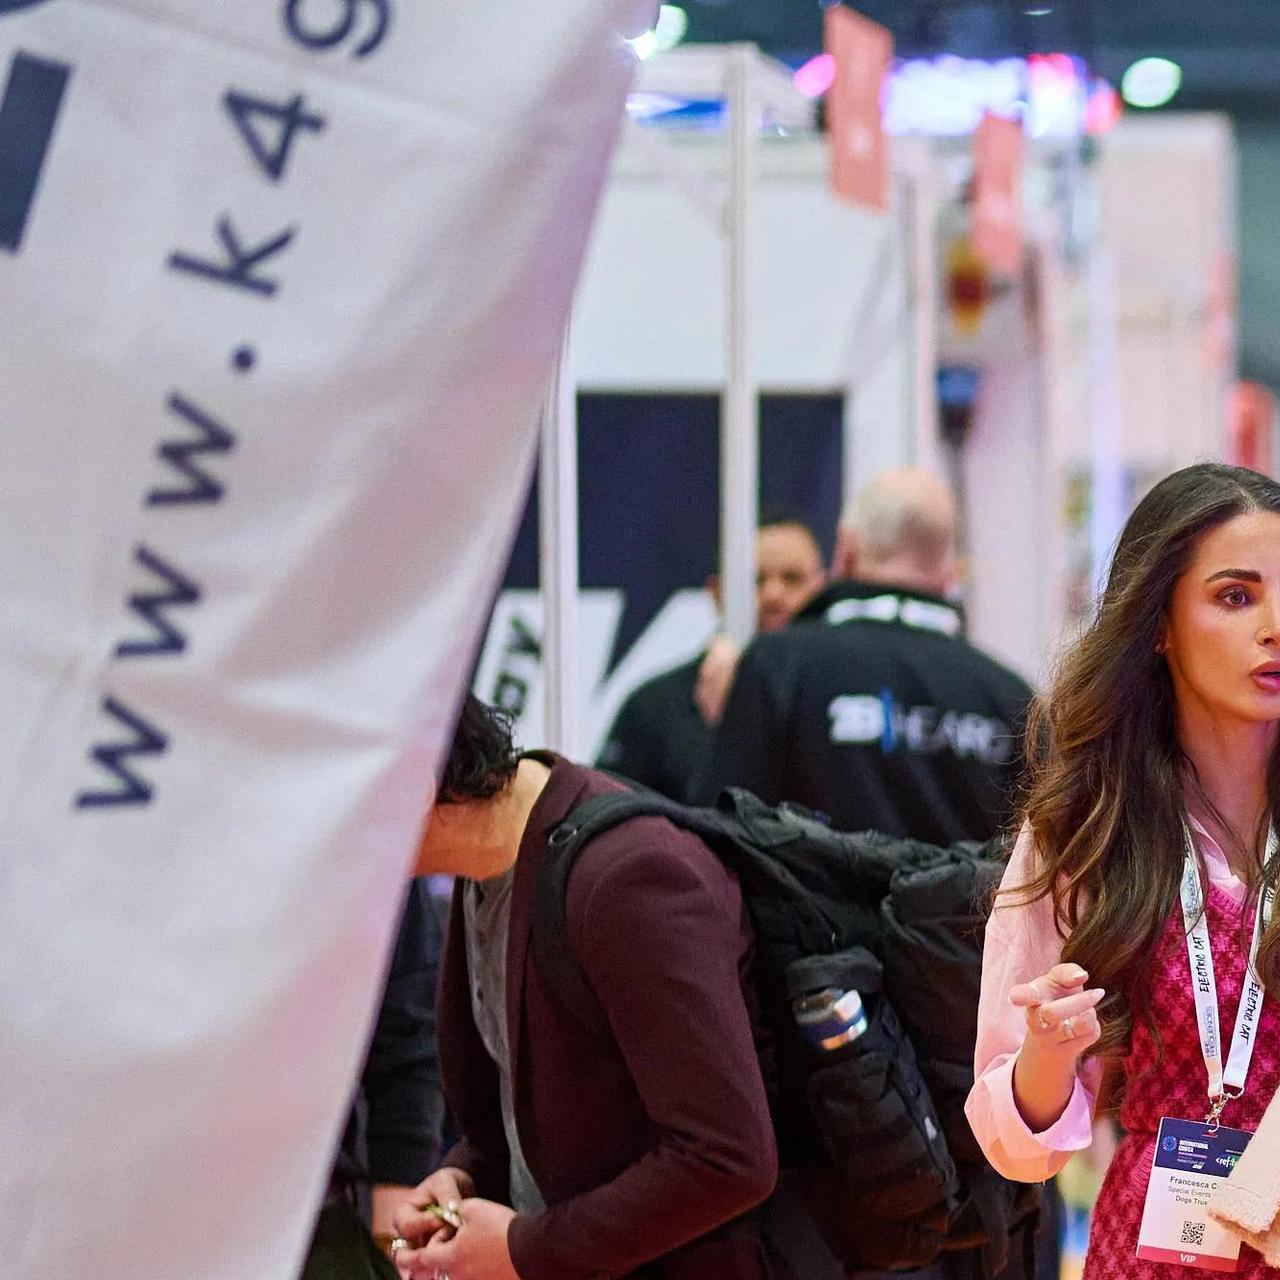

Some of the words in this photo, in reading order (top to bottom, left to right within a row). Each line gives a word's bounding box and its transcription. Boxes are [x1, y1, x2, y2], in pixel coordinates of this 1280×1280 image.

[1191, 931, 1205, 950] CAT
[1195, 954, 1211, 993] ELECTRIC
[1244, 981, 1260, 1021] ELECTRIC
[1240, 1023, 1251, 1045] CAT
[1169, 1175, 1209, 1189] Francesca
[1175, 1195, 1192, 1204] Dogs
[1180, 1252, 1197, 1264] VIP
